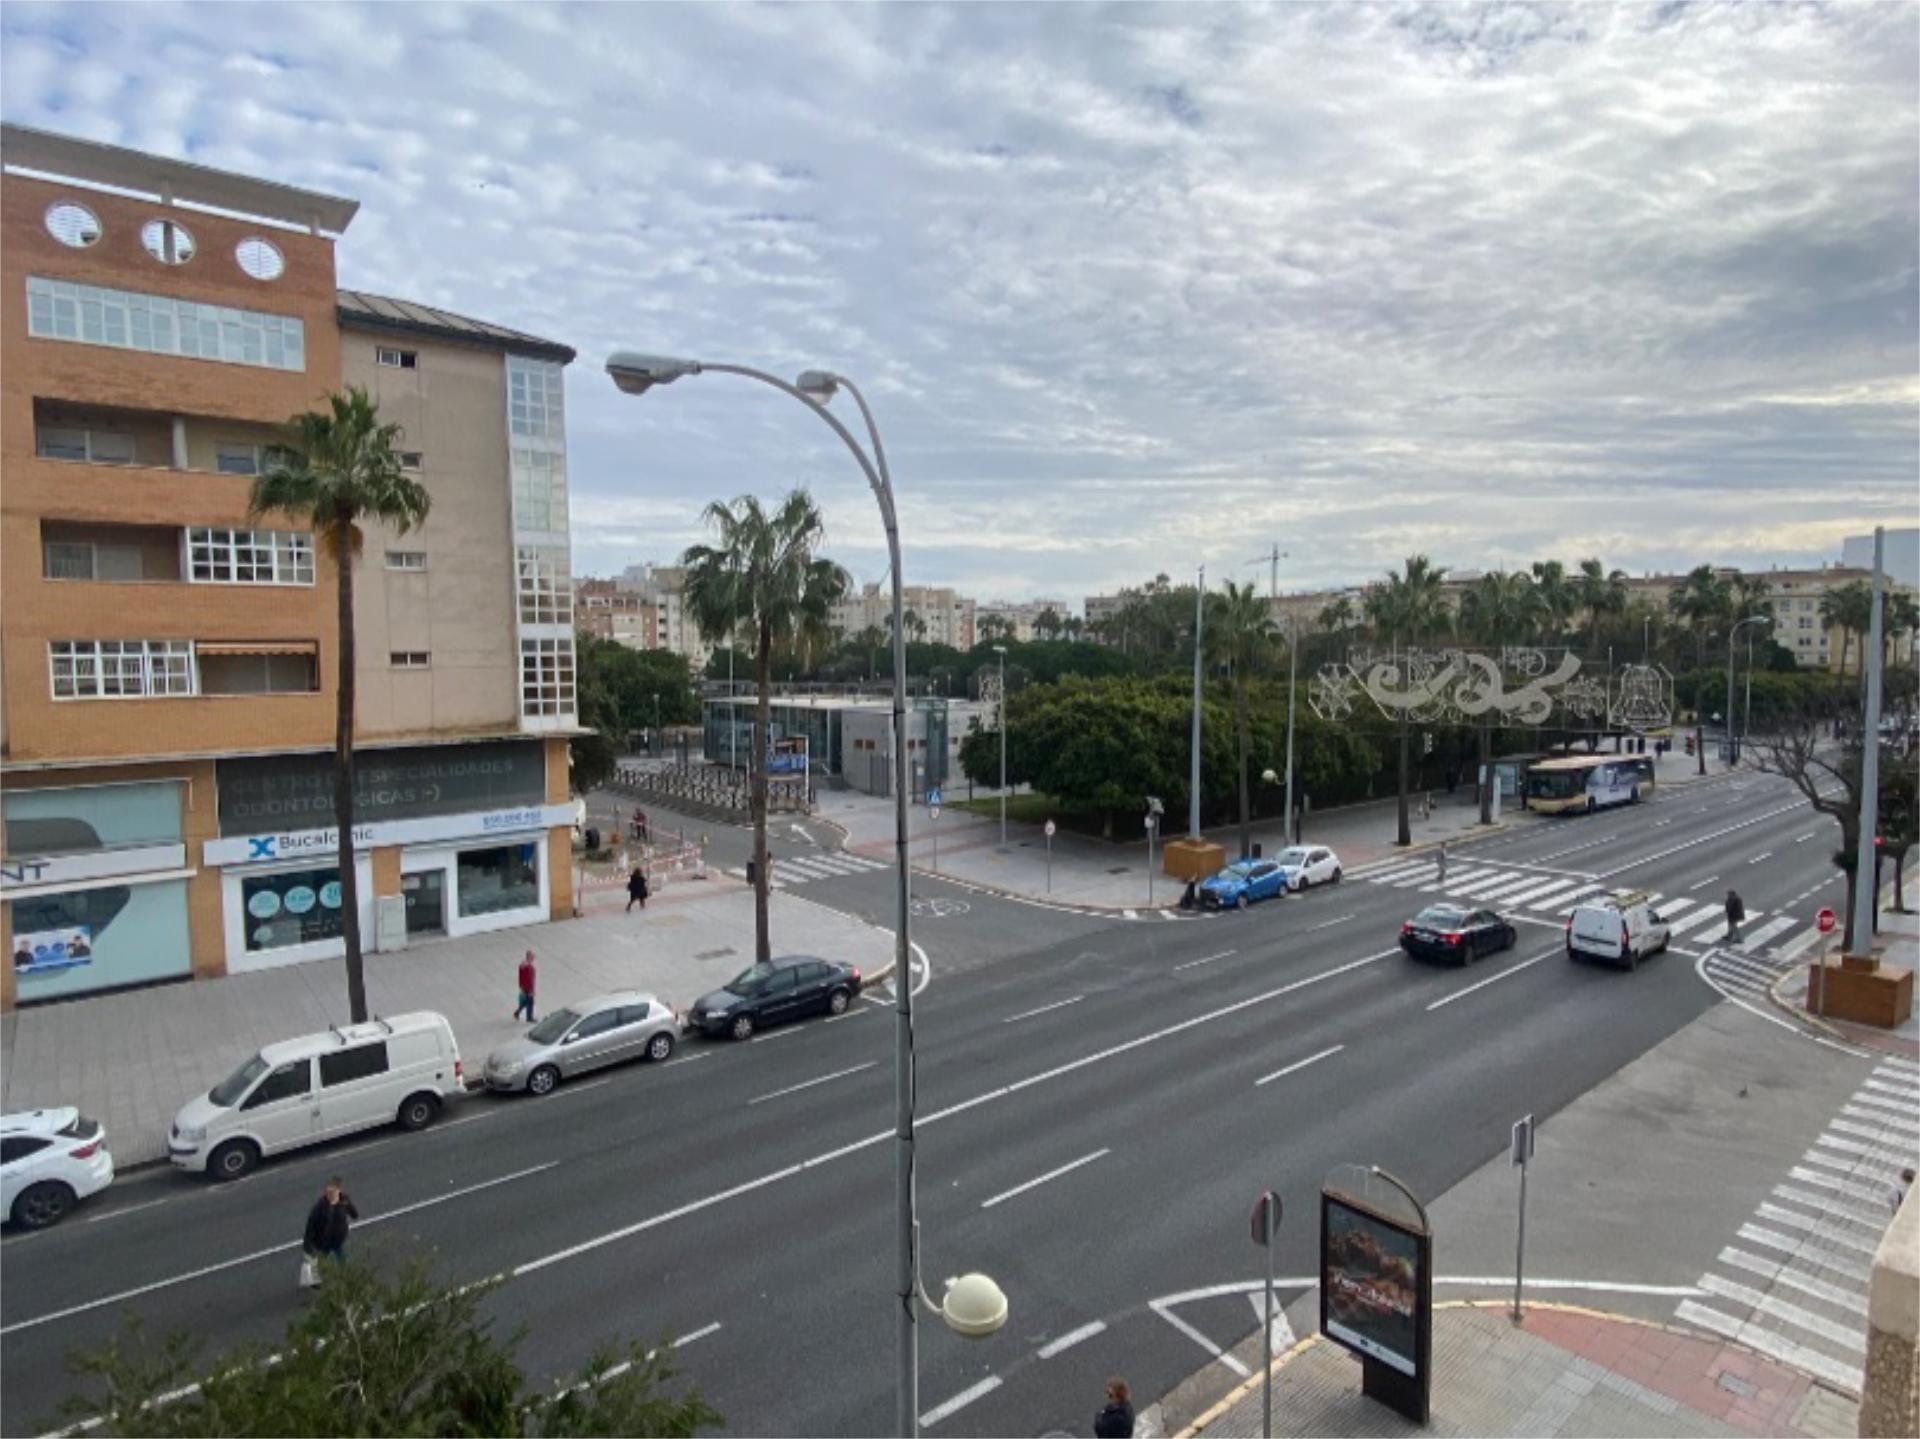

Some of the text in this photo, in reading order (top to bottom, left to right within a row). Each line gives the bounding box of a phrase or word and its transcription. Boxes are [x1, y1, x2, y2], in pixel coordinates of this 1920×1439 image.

[357, 758, 513, 784] ESPECIALIDADES
[231, 788, 417, 818] ODONTOLGICAS
[279, 828, 374, 849] Bucalcnic
